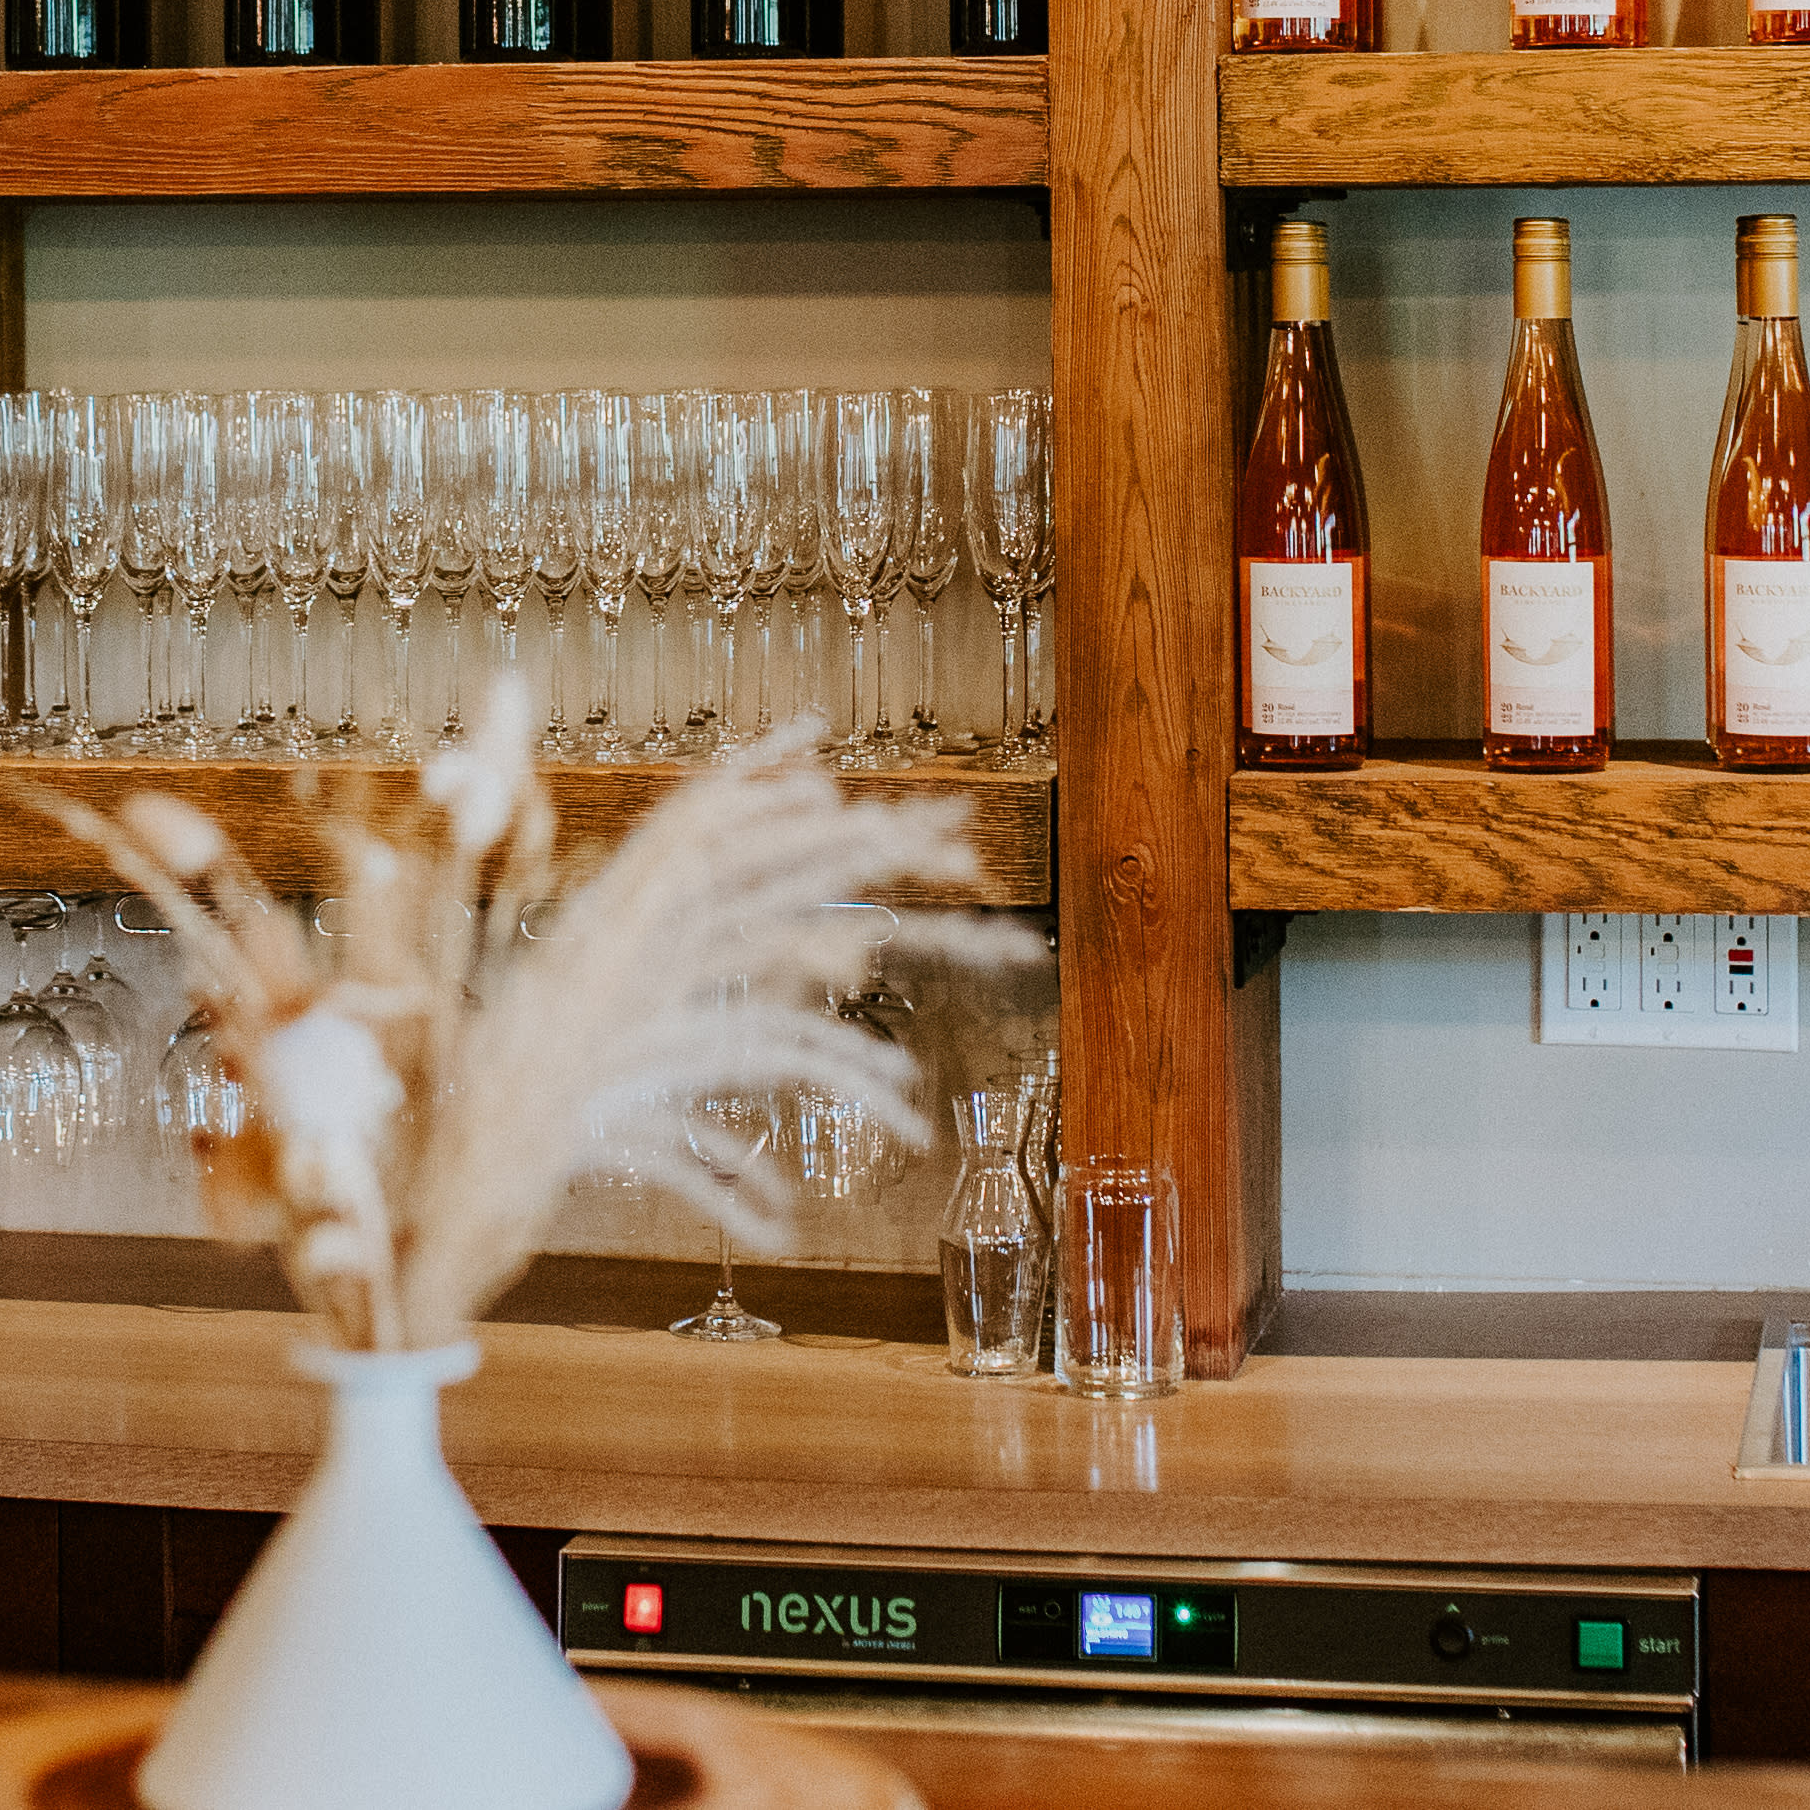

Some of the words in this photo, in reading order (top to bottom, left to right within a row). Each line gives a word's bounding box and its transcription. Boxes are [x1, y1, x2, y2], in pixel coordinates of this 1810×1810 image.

[1261, 585, 1342, 598] BACKYARD
[1500, 584, 1583, 597] BACKYARD
[741, 1591, 917, 1638] nexus
[1638, 1636, 1681, 1654] start
